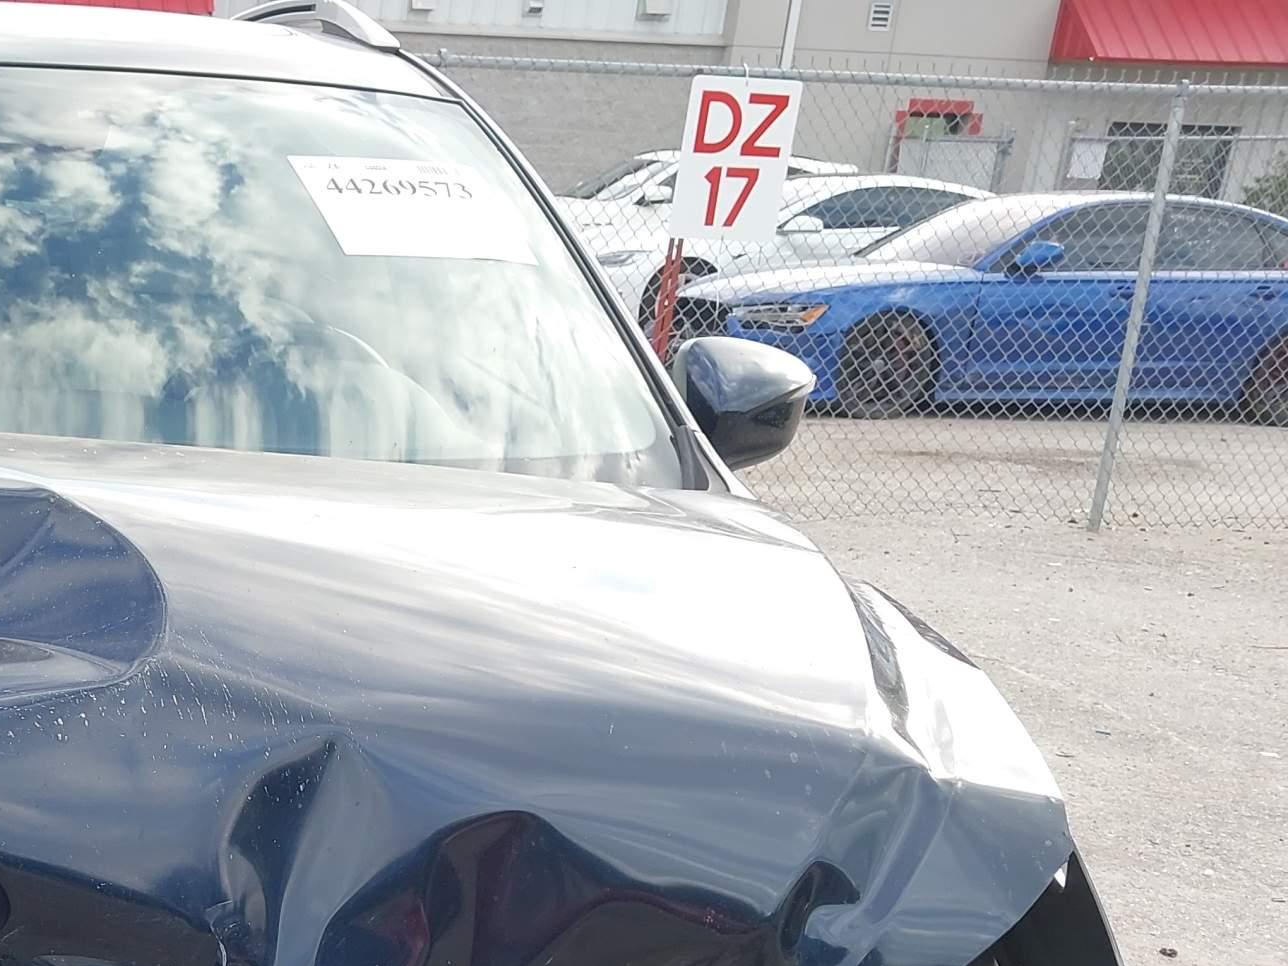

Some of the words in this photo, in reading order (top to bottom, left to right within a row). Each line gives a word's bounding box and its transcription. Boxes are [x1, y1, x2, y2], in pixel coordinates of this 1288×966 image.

[693, 90, 790, 158] DZ
[326, 177, 473, 200] 44269573
[704, 166, 760, 227] 17
